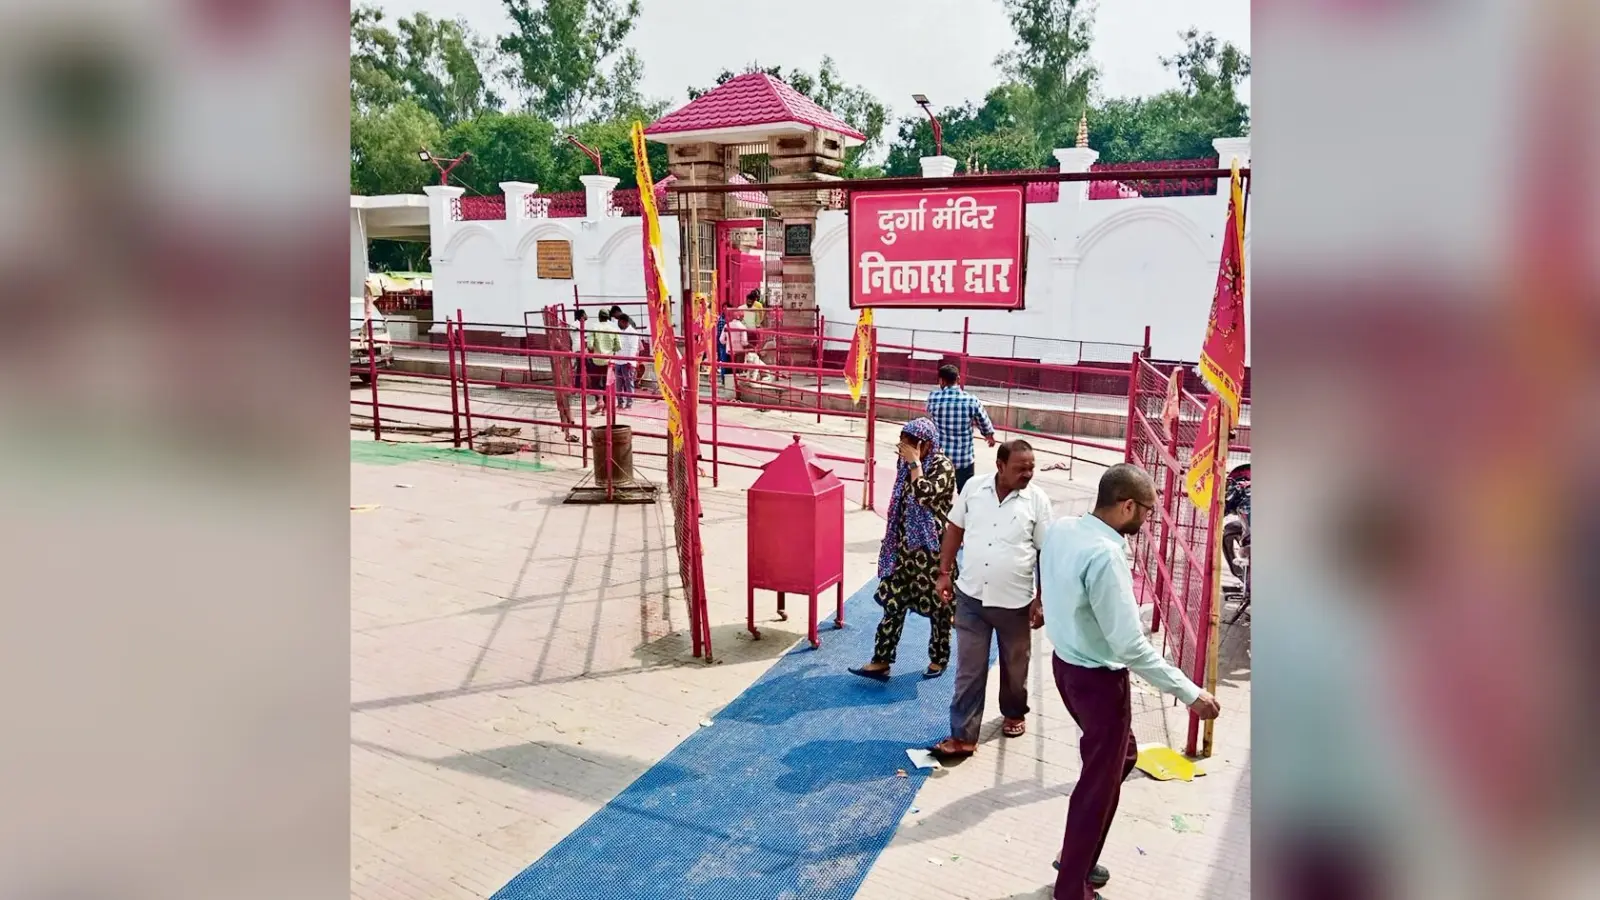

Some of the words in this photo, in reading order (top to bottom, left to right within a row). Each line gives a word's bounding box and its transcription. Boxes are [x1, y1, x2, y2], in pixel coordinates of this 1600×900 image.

[877, 198, 928, 245] दुर्गा
[932, 196, 997, 230] मंदिर
[859, 251, 957, 295] निकास
[962, 258, 1013, 294] द्वार
